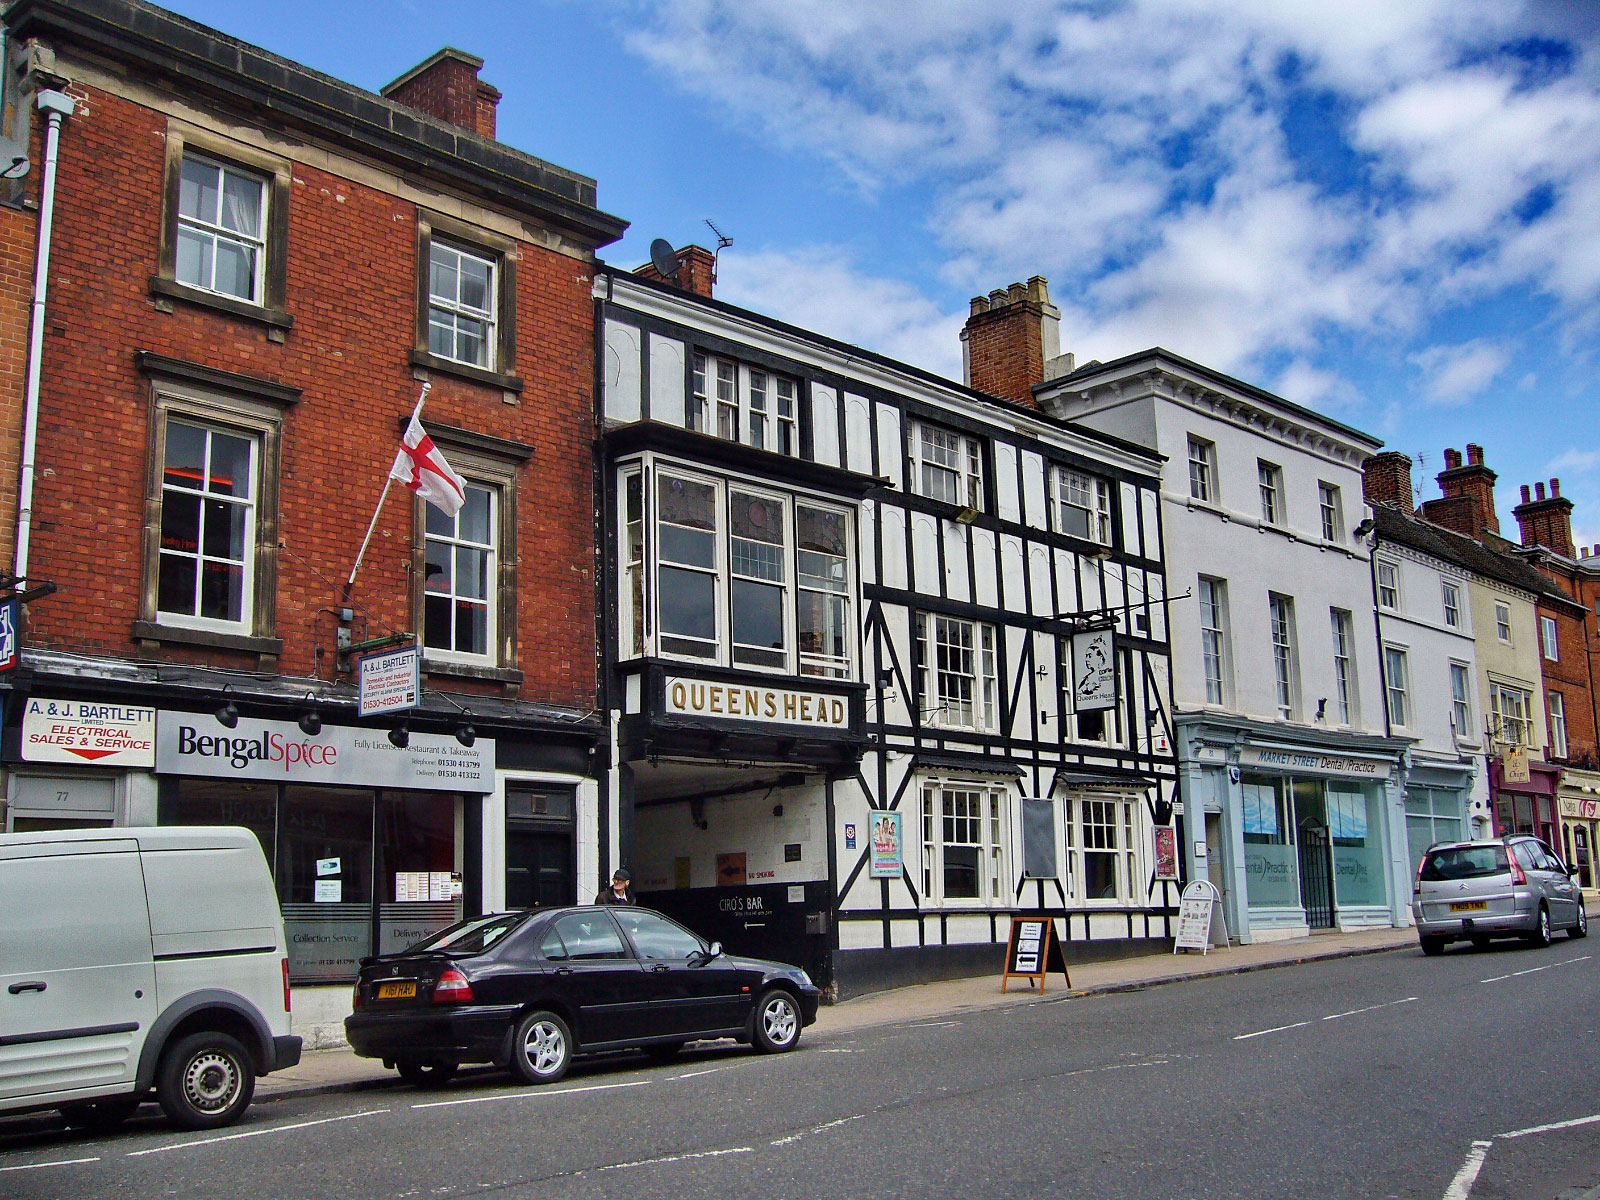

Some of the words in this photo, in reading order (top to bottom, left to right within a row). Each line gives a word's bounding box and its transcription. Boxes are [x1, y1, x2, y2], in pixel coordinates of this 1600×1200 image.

[382, 654, 414, 669] BARTLETT
[1077, 694, 1098, 702] Queens
[29, 701, 44, 715] A.
[47, 702, 58, 716] &
[61, 704, 74, 717] J.
[79, 705, 154, 722] BARTLETT
[51, 725, 132, 739] ELECTRICAL
[29, 734, 75, 746] SALES
[79, 737, 89, 746] &
[94, 738, 151, 750] SERVICE
[354, 739, 372, 751] Fully
[441, 747, 448, 755] &
[450, 747, 480, 758] Takeaway
[437, 758, 457, 768] 01530
[458, 759, 481, 769] 413799
[1258, 750, 1292, 765] MARKET
[1293, 753, 1319, 769] STREET
[437, 769, 457, 779] 01530
[56, 791, 69, 802] 77
[719, 896, 744, 911] CIRO'S
[746, 896, 764, 910] BAR
[293, 933, 331, 943] Collection
[332, 933, 359, 943] Service
[393, 929, 421, 940] Delivery
